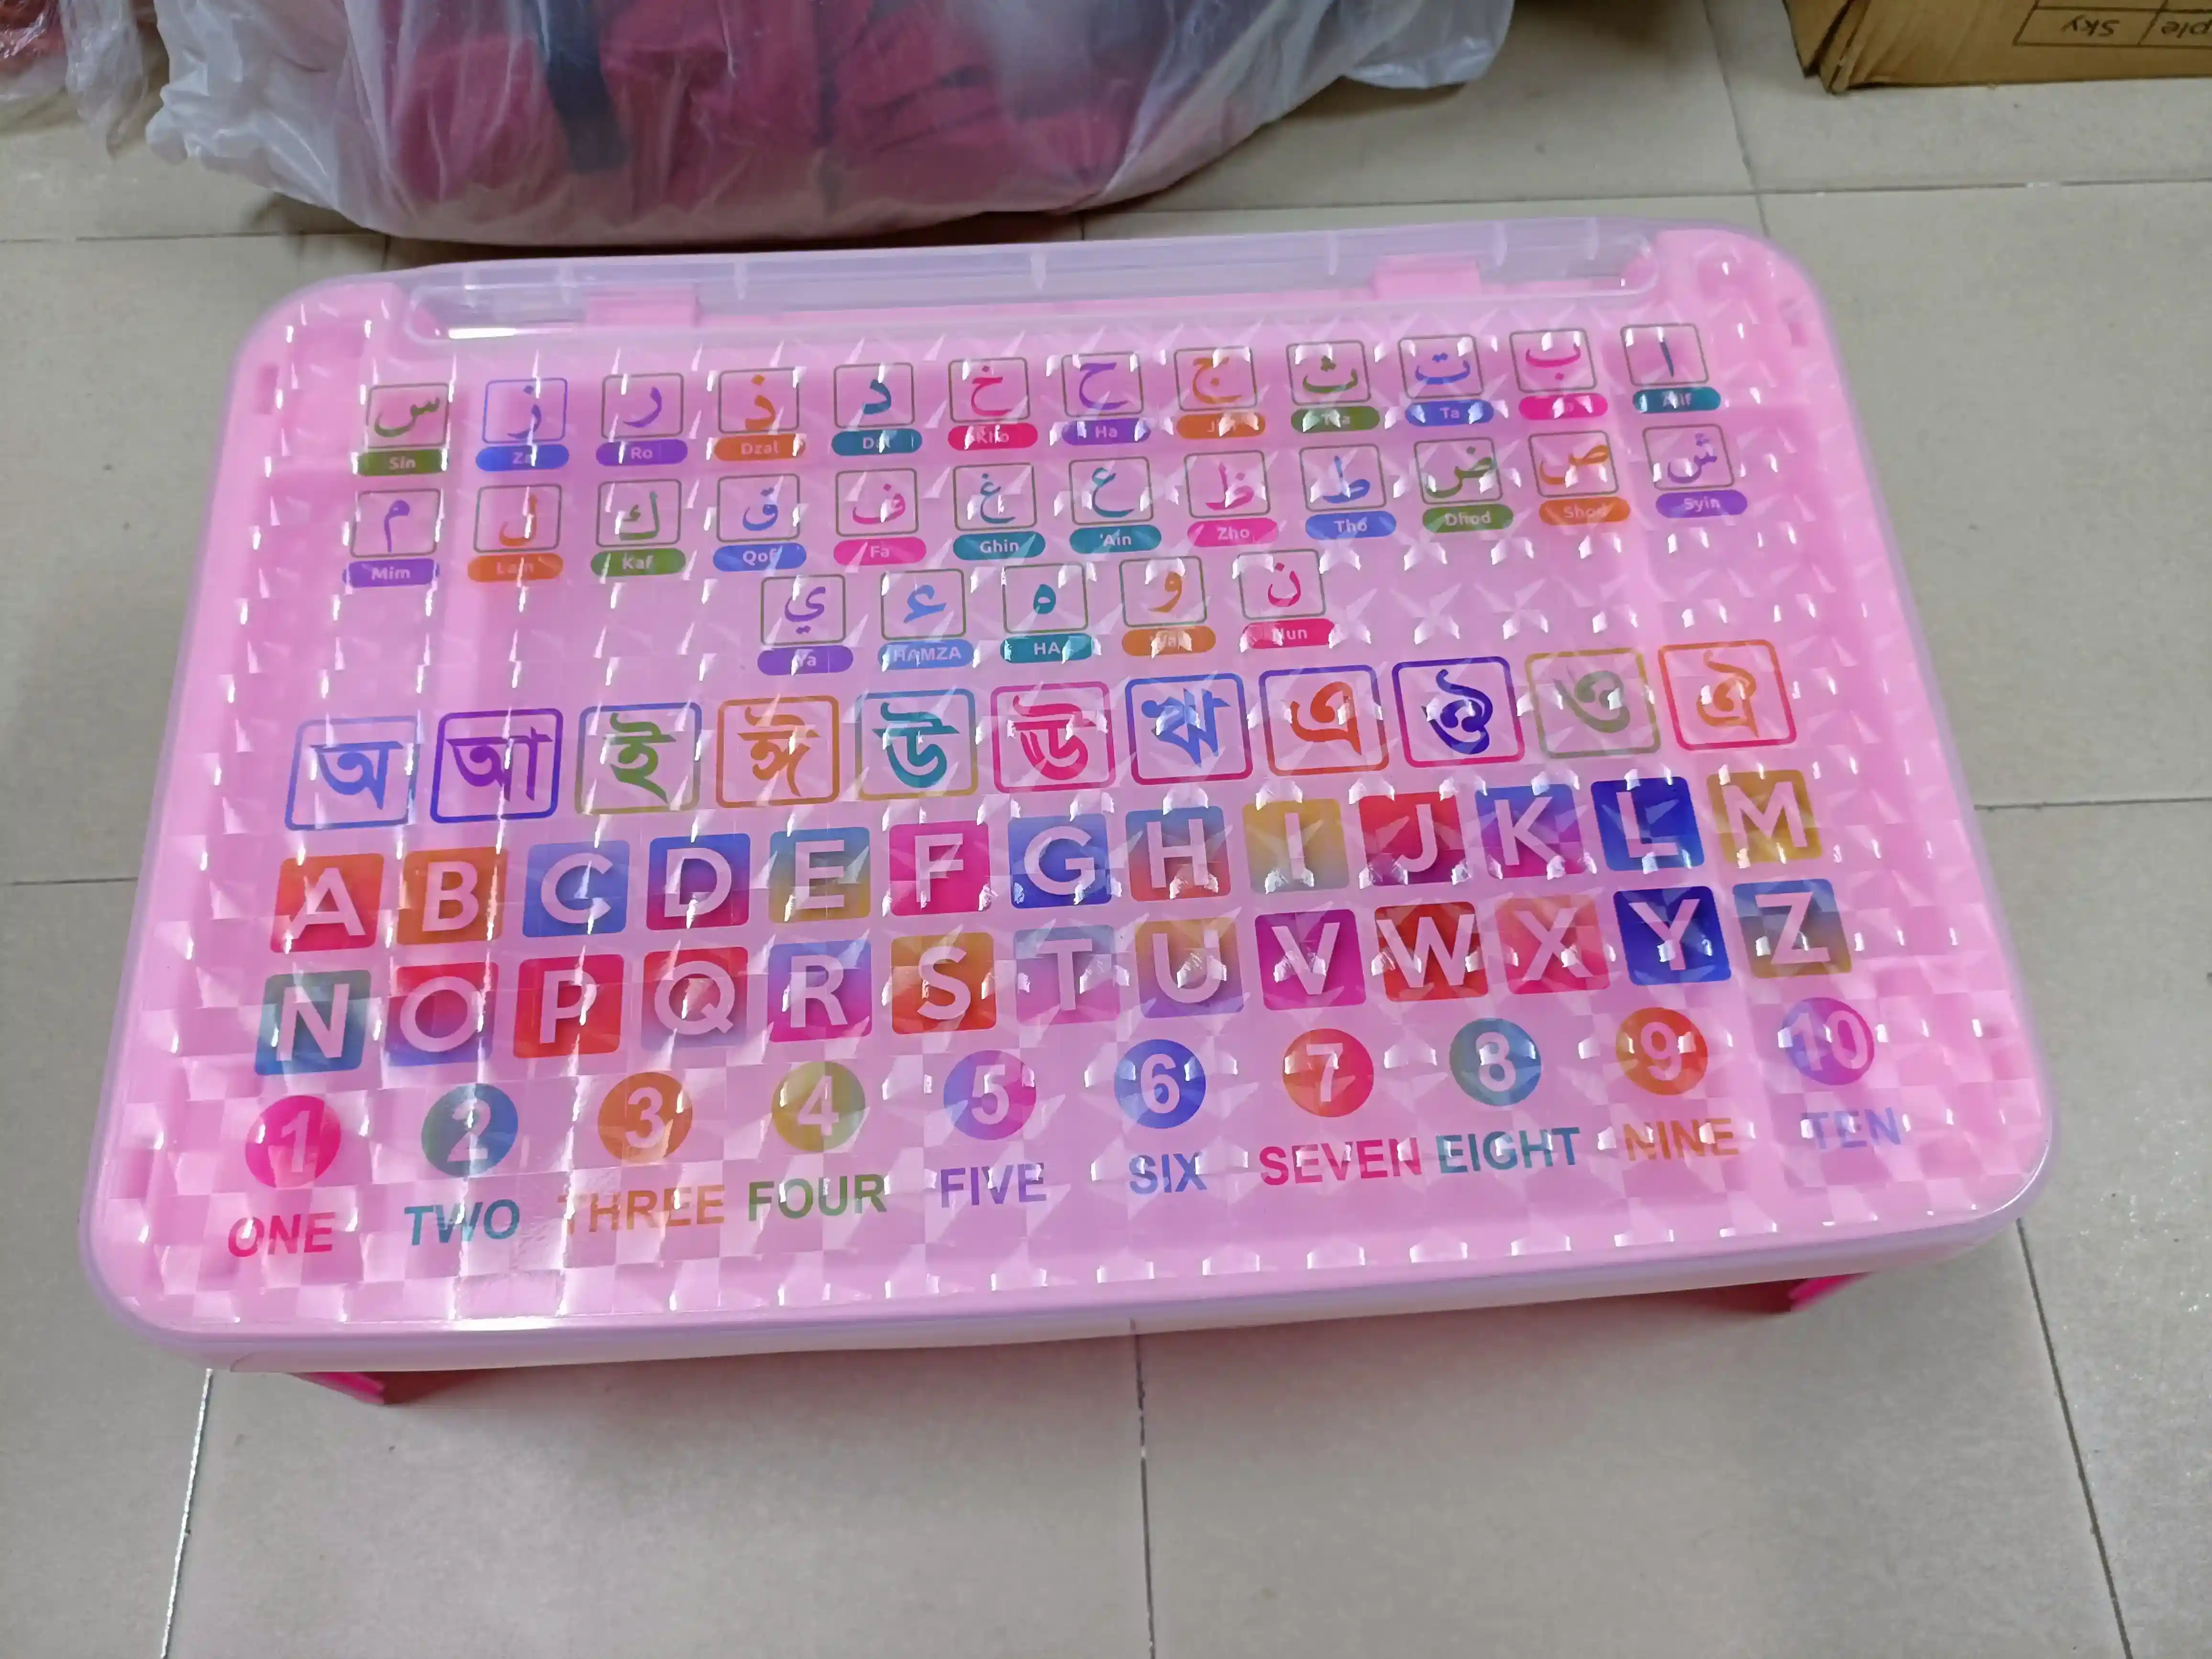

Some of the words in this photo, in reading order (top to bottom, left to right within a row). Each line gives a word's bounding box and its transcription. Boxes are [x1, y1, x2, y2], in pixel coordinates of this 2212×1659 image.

[1080, 362, 1128, 410] ح
[1192, 357, 1242, 405] ج
[1302, 355, 1358, 393] ث
[1415, 352, 1471, 385] ت
[1525, 345, 1582, 381] ب
[507, 385, 542, 439] ز
[623, 387, 662, 428] ر
[745, 375, 776, 430] ذ
[863, 379, 892, 415] د
[971, 365, 1012, 416] خ
[374, 397, 441, 437] س
[389, 455, 416, 470] Sin
[630, 447, 653, 460] Ro
[741, 442, 779, 456] Dzal
[1095, 426, 1118, 439] Ha
[1440, 407, 1460, 419] Ta
[1323, 456, 1371, 504] ط
[1426, 445, 1493, 499] ض
[1539, 444, 1610, 486] ص
[1667, 433, 1717, 484] ش
[742, 488, 779, 531] ق
[852, 483, 906, 525] ف
[979, 473, 1016, 524] غ
[1092, 467, 1134, 518] ع
[1205, 462, 1254, 511] ظ
[371, 567, 410, 581] Mim
[622, 555, 653, 570] Kaf
[742, 550, 778, 566] Qof
[870, 544, 890, 558] Fa
[980, 539, 1020, 554] Ghin
[1217, 526, 1249, 541] Zho
[1334, 520, 1367, 533] Tho
[1445, 511, 1492, 527] Dhod
[1564, 503, 1606, 519] Shod
[1683, 496, 1721, 512] Syin
[384, 500, 410, 553] م
[499, 494, 538, 546] ل
[1033, 584, 1056, 615] ه
[1147, 571, 1183, 613] و
[1268, 562, 1301, 608] ن
[785, 586, 826, 634] ي
[797, 654, 817, 667] Ya
[894, 646, 962, 663] HAMZA
[1034, 641, 1061, 655] HA
[1272, 628, 1307, 641] Nun
[309, 740, 403, 810] অ
[446, 726, 553, 802] আ
[601, 712, 676, 805] ই
[737, 706, 820, 796] ঈ
[872, 702, 960, 789] উ
[1009, 695, 1097, 781] ঊ
[1140, 687, 1231, 768] ঋ
[1290, 681, 1362, 756] এ
[1421, 669, 1493, 754] ঔ
[1554, 671, 1630, 733] ও
[1696, 649, 1759, 738] ঐ
[288, 867, 366, 940] A
[421, 861, 479, 932] B
[540, 852, 614, 924] C
[664, 847, 732, 918] D
[795, 839, 845, 909] E
[914, 833, 963, 903] F
[1024, 825, 1096, 896] G
[1147, 818, 1209, 888] H
[1284, 812, 1305, 880] I
[1396, 803, 1438, 873] J
[1494, 796, 1565, 866] K
[1615, 791, 1679, 858] L
[1722, 781, 1807, 852] M
[276, 983, 350, 1062] N
[399, 976, 483, 1052] O
[539, 969, 597, 1044] P
[654, 961, 735, 1035] Q
[790, 955, 848, 1028] R
[917, 945, 971, 1020] S
[1036, 938, 1093, 1011] T
[1152, 929, 1221, 1004] U
[1272, 922, 1340, 995] V
[1375, 914, 1475, 988] W
[1514, 907, 1594, 981] X
[1628, 898, 1701, 971] Y
[1755, 892, 1831, 964] Z
[281, 1110, 310, 1173] 1
[447, 1098, 492, 1162] 2
[623, 1086, 666, 1148] 3
[797, 1075, 839, 1136] 4
[971, 1064, 1009, 1125] 5
[1140, 1053, 1180, 1114] 6
[1306, 1042, 1343, 1102] 7
[1476, 1031, 1516, 1092] 8
[1640, 1021, 1682, 1081] 9
[1790, 1009, 1869, 1072] 10
[228, 1212, 335, 1258] ONE
[404, 1199, 520, 1246] TWO
[748, 1173, 887, 1222] FOUR
[940, 1162, 1047, 1208] FIVE
[1129, 1151, 1207, 1194] SIX
[1259, 1137, 1422, 1185] SEVEN
[1436, 1127, 1580, 1174] EIGHT
[1623, 1117, 1739, 1161] NINE
[1800, 1107, 1901, 1149] TEN
